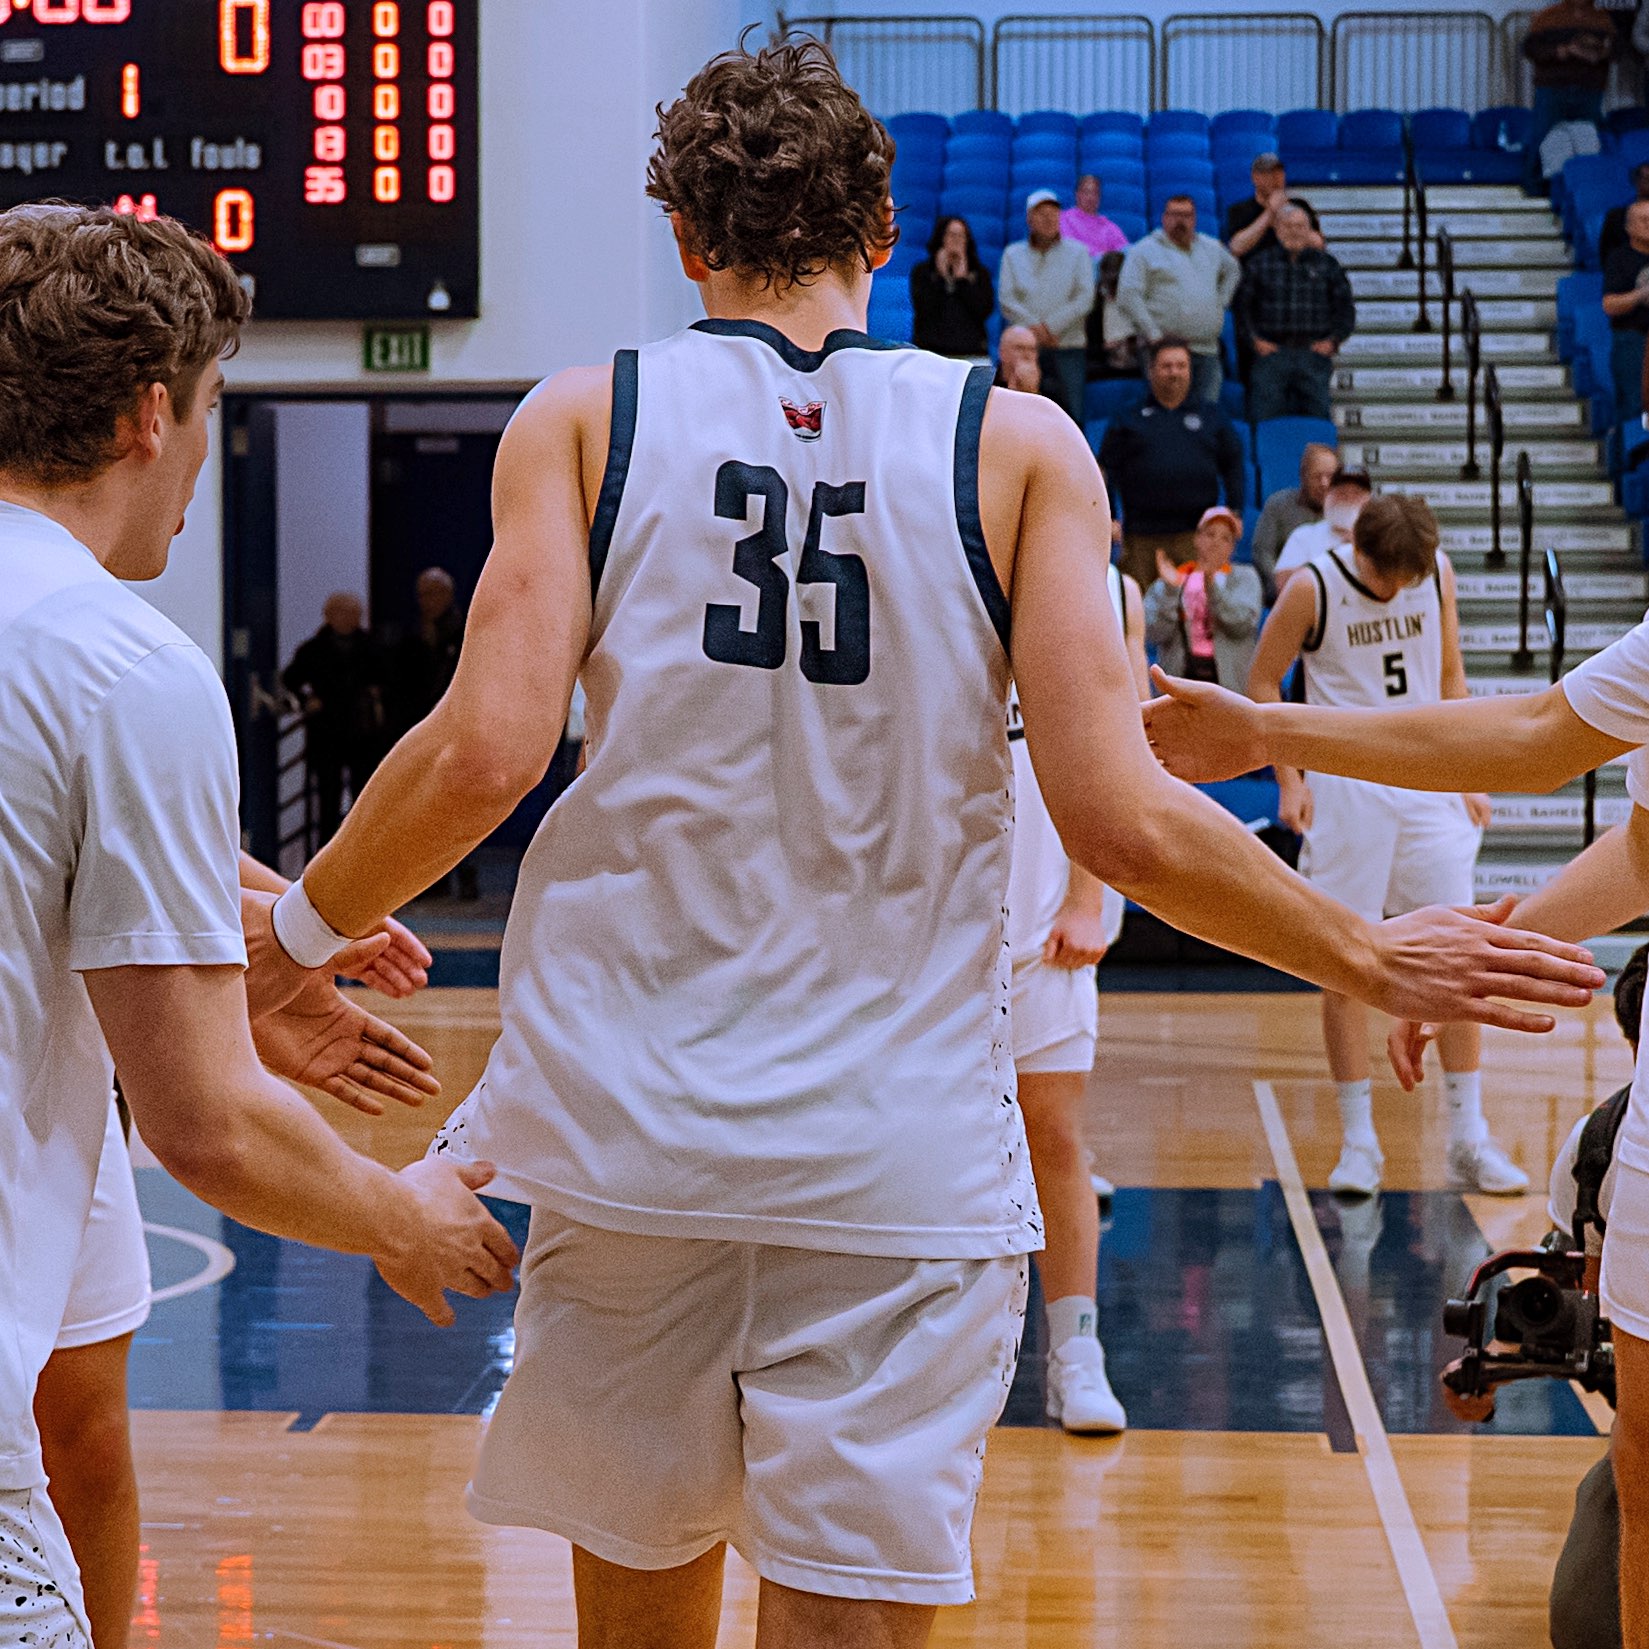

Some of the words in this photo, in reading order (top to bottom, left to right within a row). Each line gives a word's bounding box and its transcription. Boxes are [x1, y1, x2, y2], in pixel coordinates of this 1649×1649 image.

[219, 0, 270, 74] 0
[373, 1, 400, 38] 0
[427, 0, 455, 37] 0
[373, 42, 400, 79] 0
[427, 41, 455, 78] 0
[373, 83, 400, 120] 0
[427, 82, 455, 119] 0
[374, 124, 400, 161] 0
[428, 123, 455, 161] 0
[374, 165, 401, 203] 0
[428, 164, 455, 202] 0
[215, 188, 254, 252] 0
[702, 460, 870, 685] 35
[1383, 651, 1408, 697] 5
